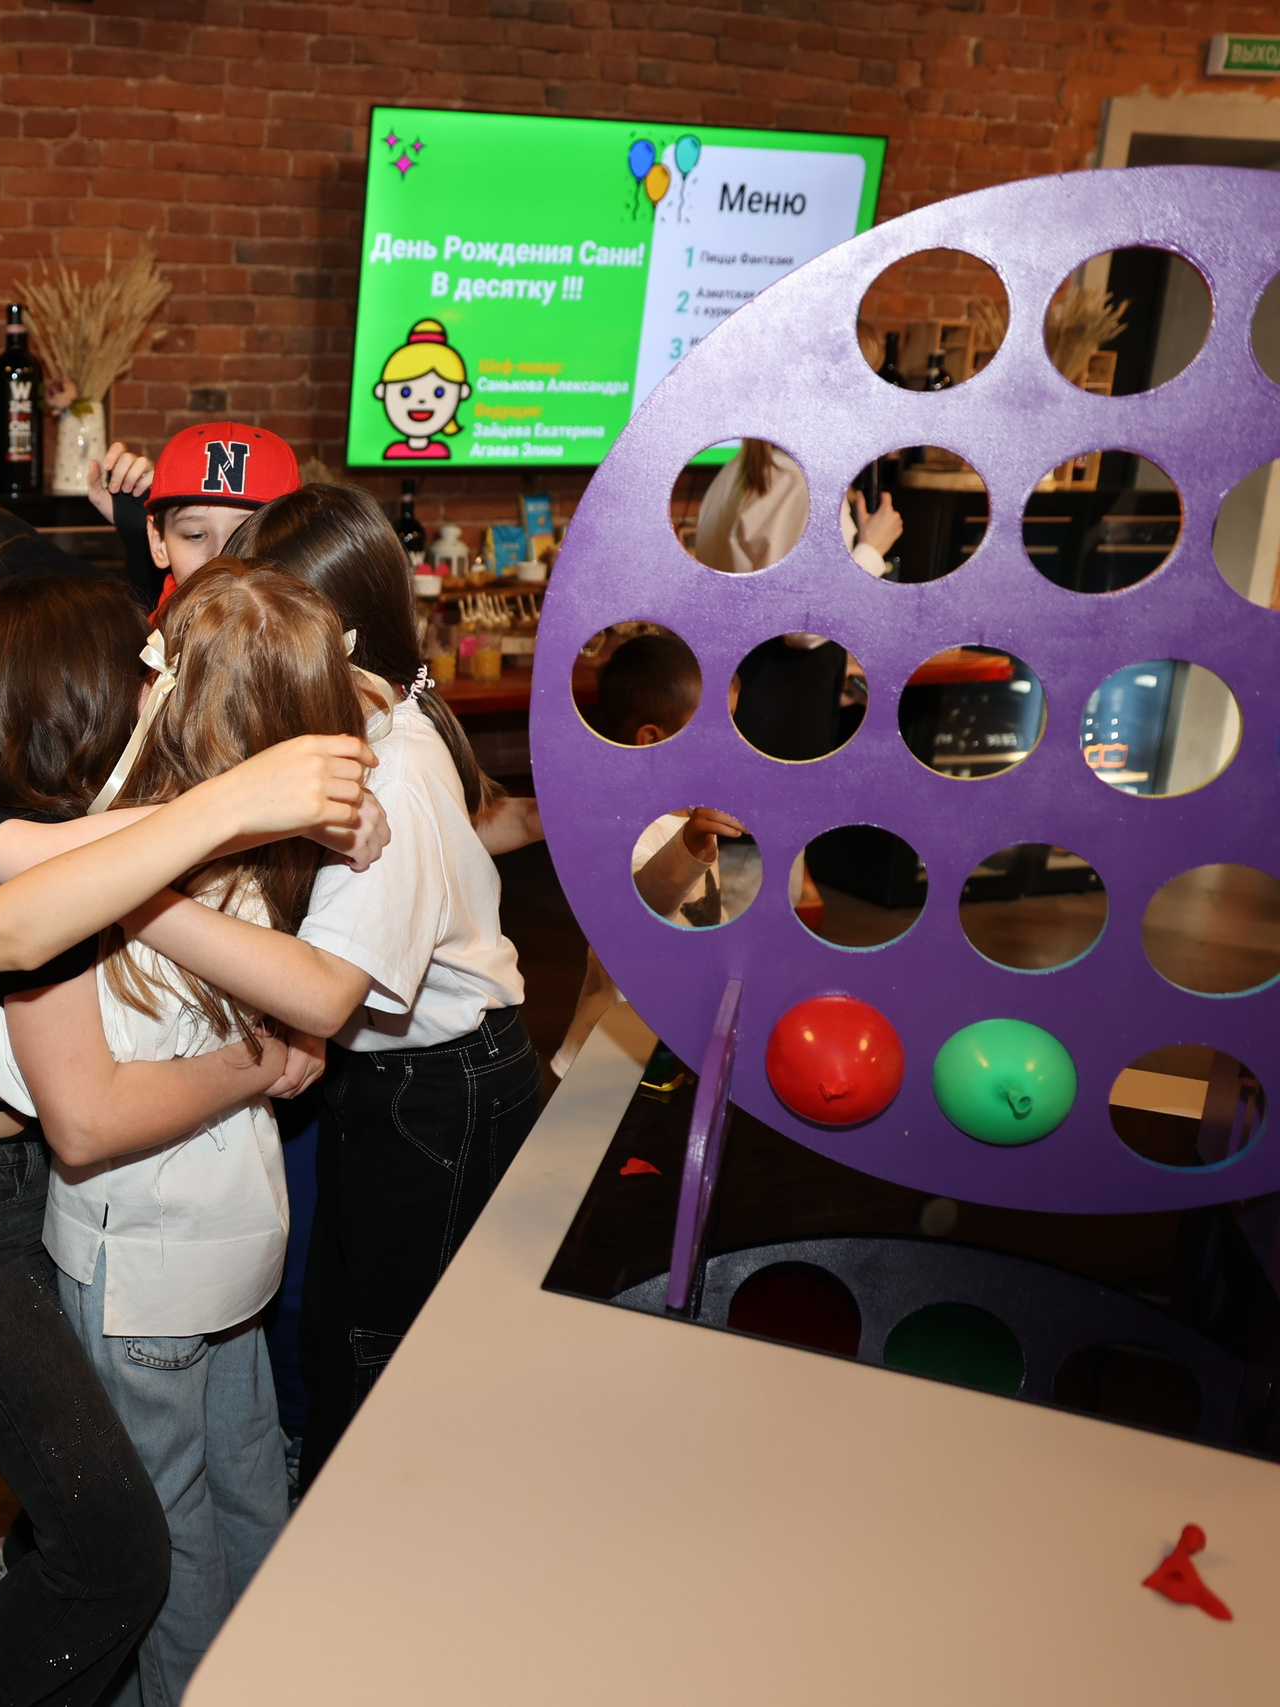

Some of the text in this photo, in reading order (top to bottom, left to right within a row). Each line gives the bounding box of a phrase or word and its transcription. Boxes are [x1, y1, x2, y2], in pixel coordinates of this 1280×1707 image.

[718, 182, 807, 216] Меню
[370, 232, 646, 268] День Рождения Сани!
[684, 246, 695, 268] 1
[700, 249, 737, 265] Пицца
[431, 271, 450, 297] В
[453, 276, 557, 307] десятку
[676, 290, 690, 313] 2
[670, 337, 683, 360] 3
[476, 376, 629, 396] Санькова Александра
[472, 422, 605, 441] Зайцева Екатерина
[469, 442, 564, 458] Агаева Элина
[201, 440, 250, 495] N
